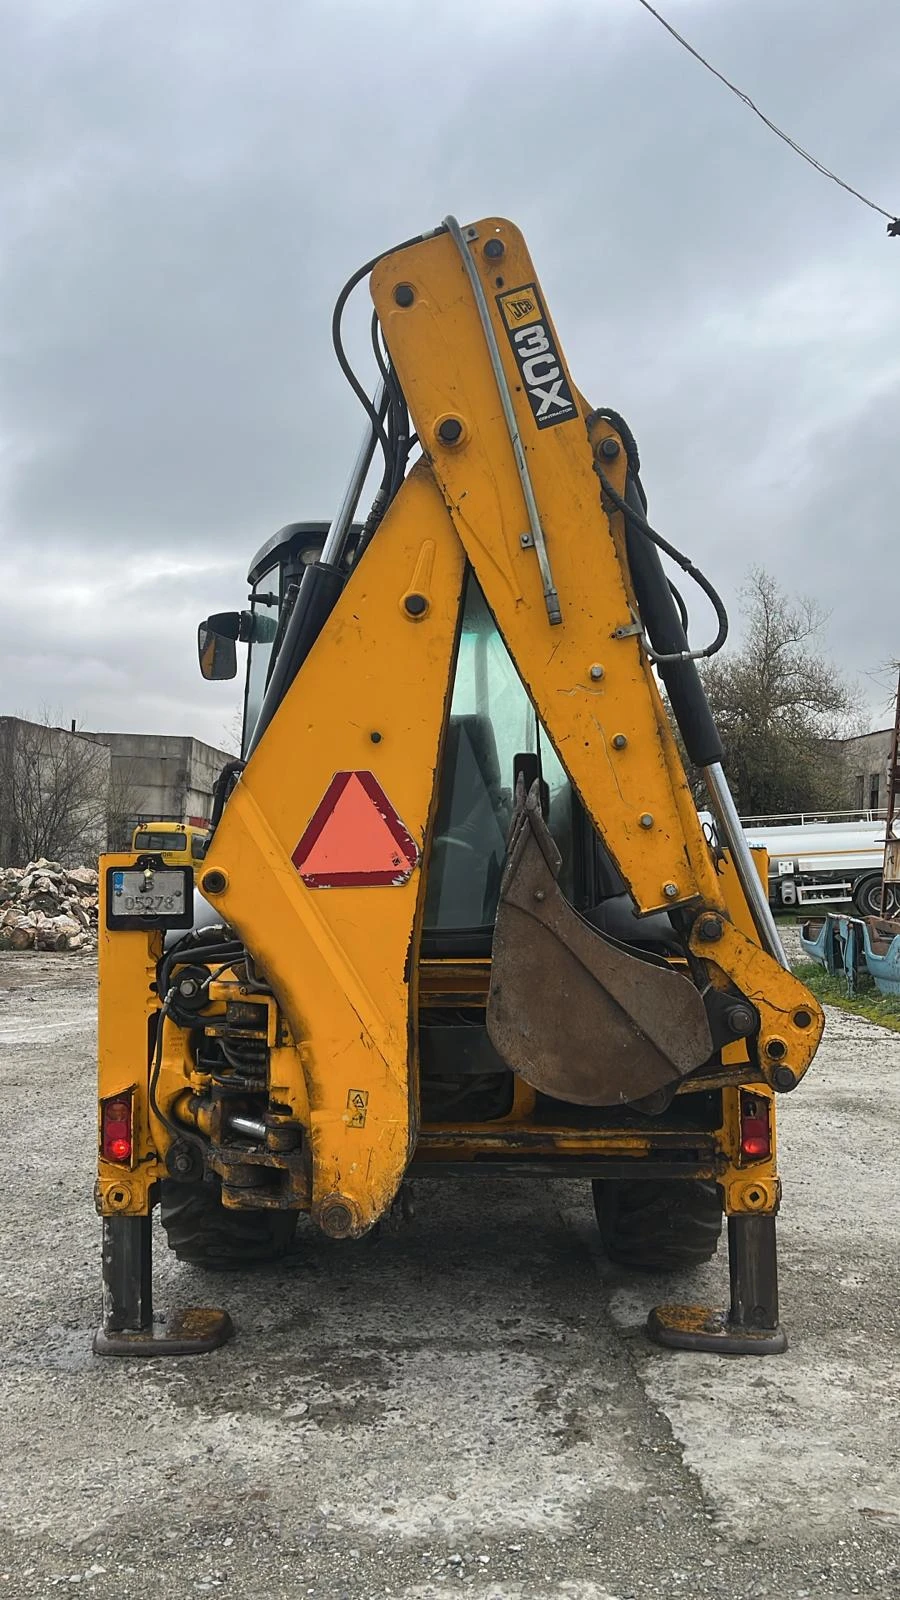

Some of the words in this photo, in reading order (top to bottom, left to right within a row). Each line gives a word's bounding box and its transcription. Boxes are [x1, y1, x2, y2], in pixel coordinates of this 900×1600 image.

[511, 301, 533, 318] JCB
[514, 325, 573, 417] 3CX
[538, 407, 573, 422] CONTRACTOR
[125, 896, 174, 911] 05278
